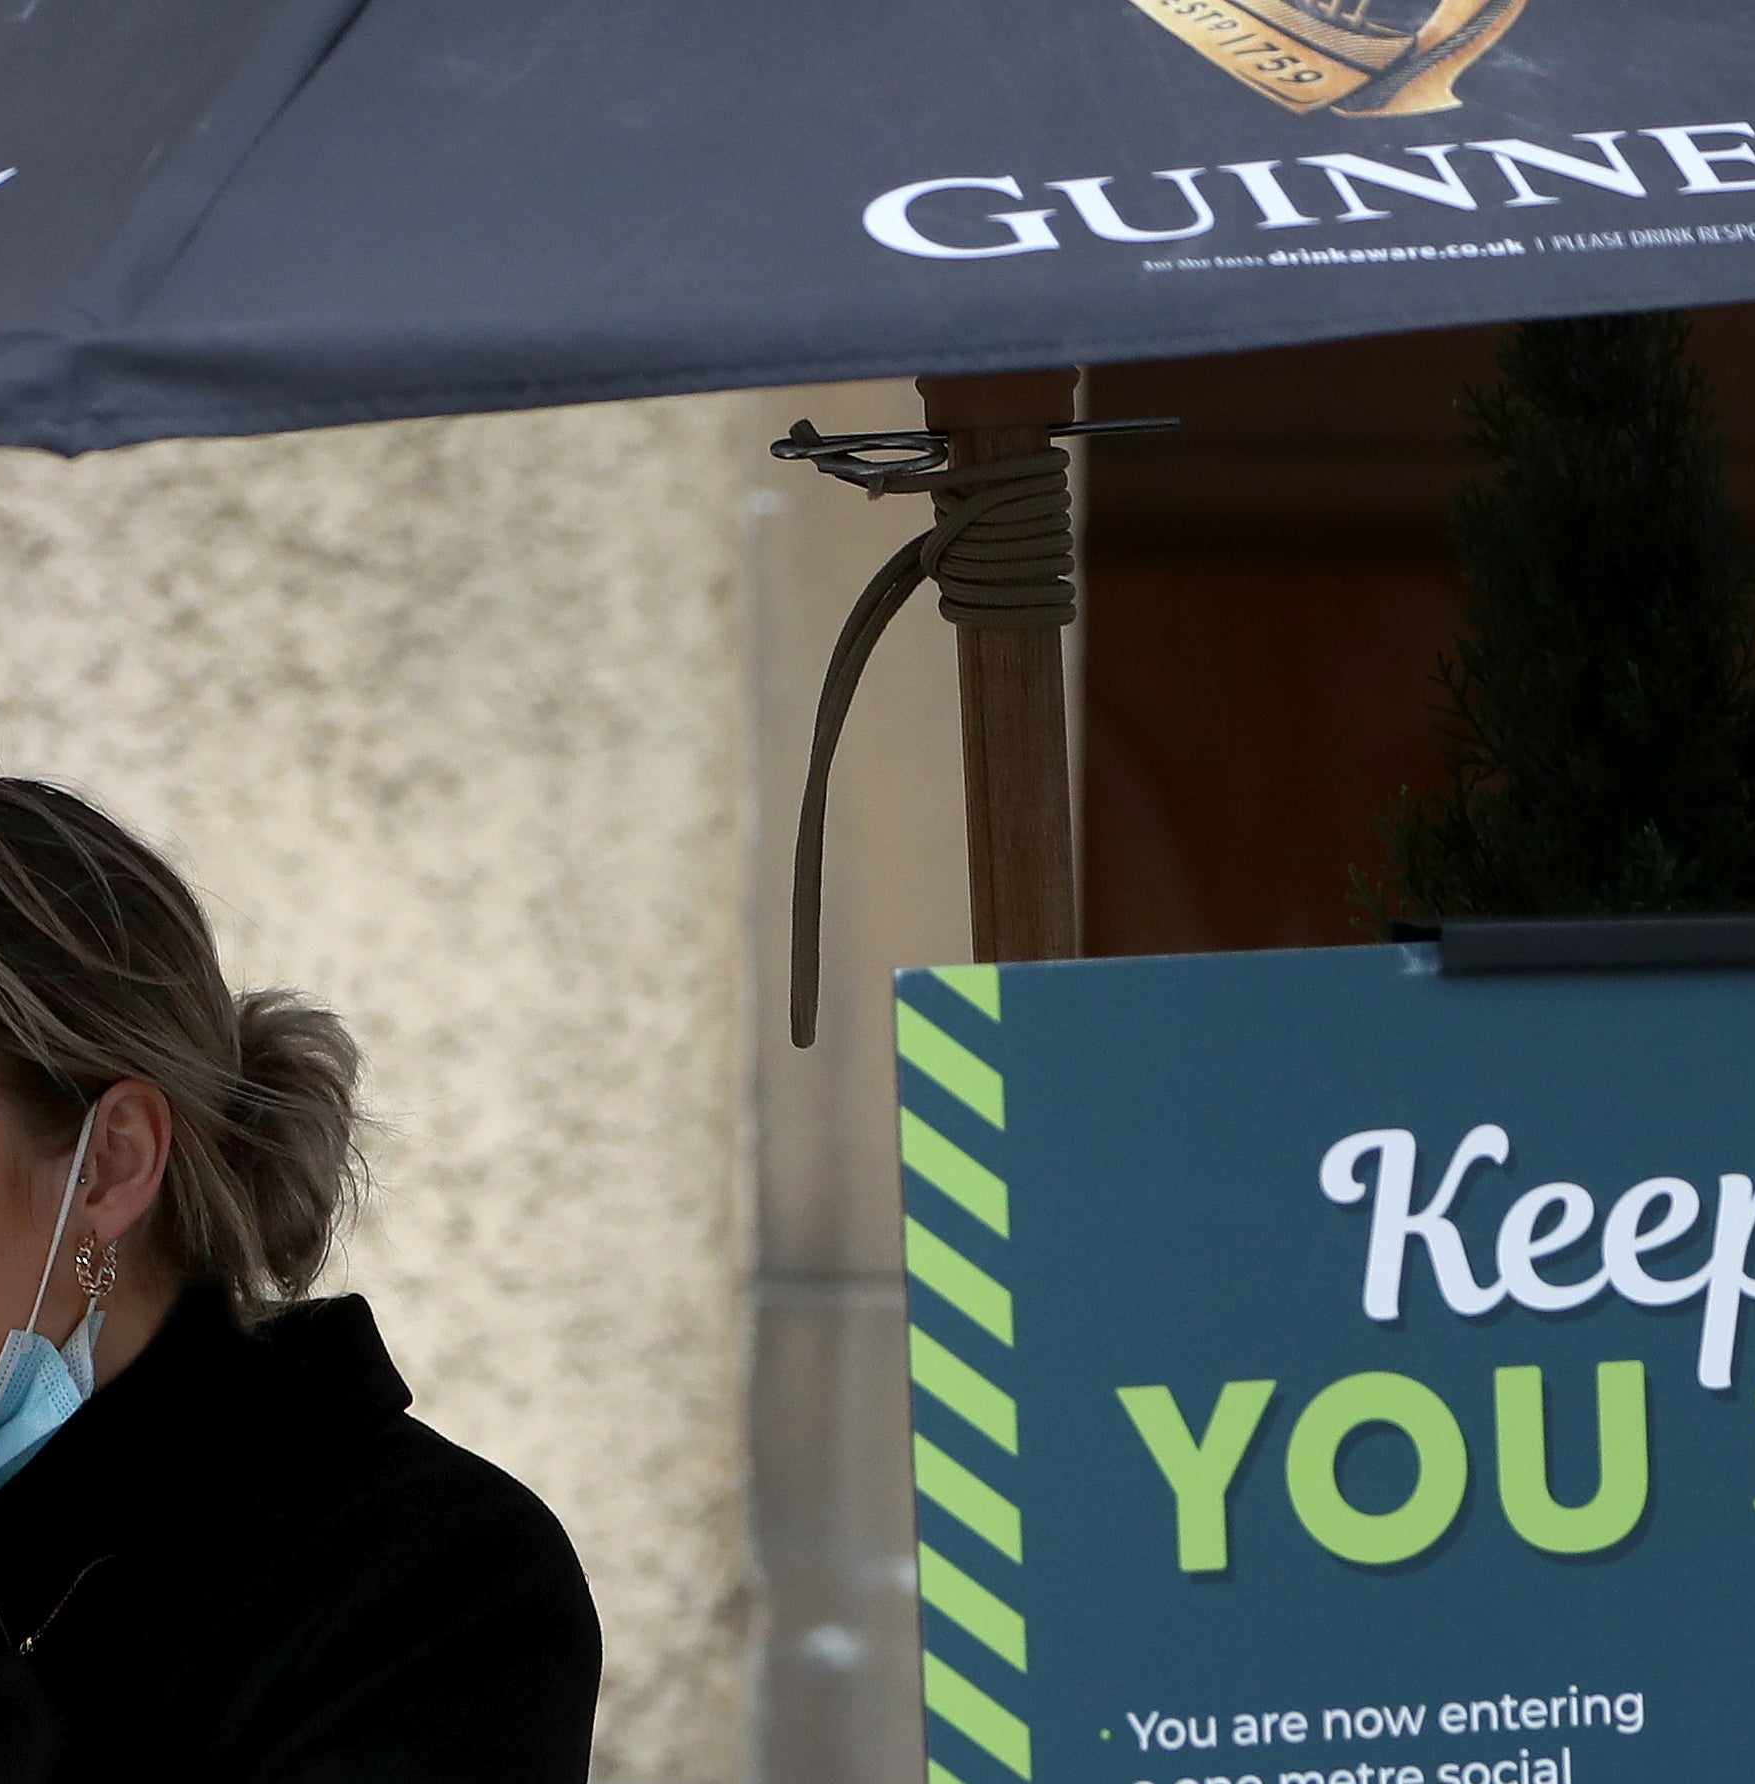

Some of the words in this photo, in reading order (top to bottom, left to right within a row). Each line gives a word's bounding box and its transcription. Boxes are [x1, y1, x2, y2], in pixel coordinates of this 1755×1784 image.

[1218, 32, 1323, 84] 1759
[1267, 237, 1526, 267] drinkaware.co.uk
[1549, 231, 1625, 252] PLEASE
[1627, 226, 1696, 248] DRINK
[1117, 1360, 1650, 1572] YOU
[1126, 1710, 1218, 1751] You
[1231, 1710, 1309, 1747] are
[1322, 1704, 1427, 1741] now
[1438, 1684, 1644, 1735] entering
